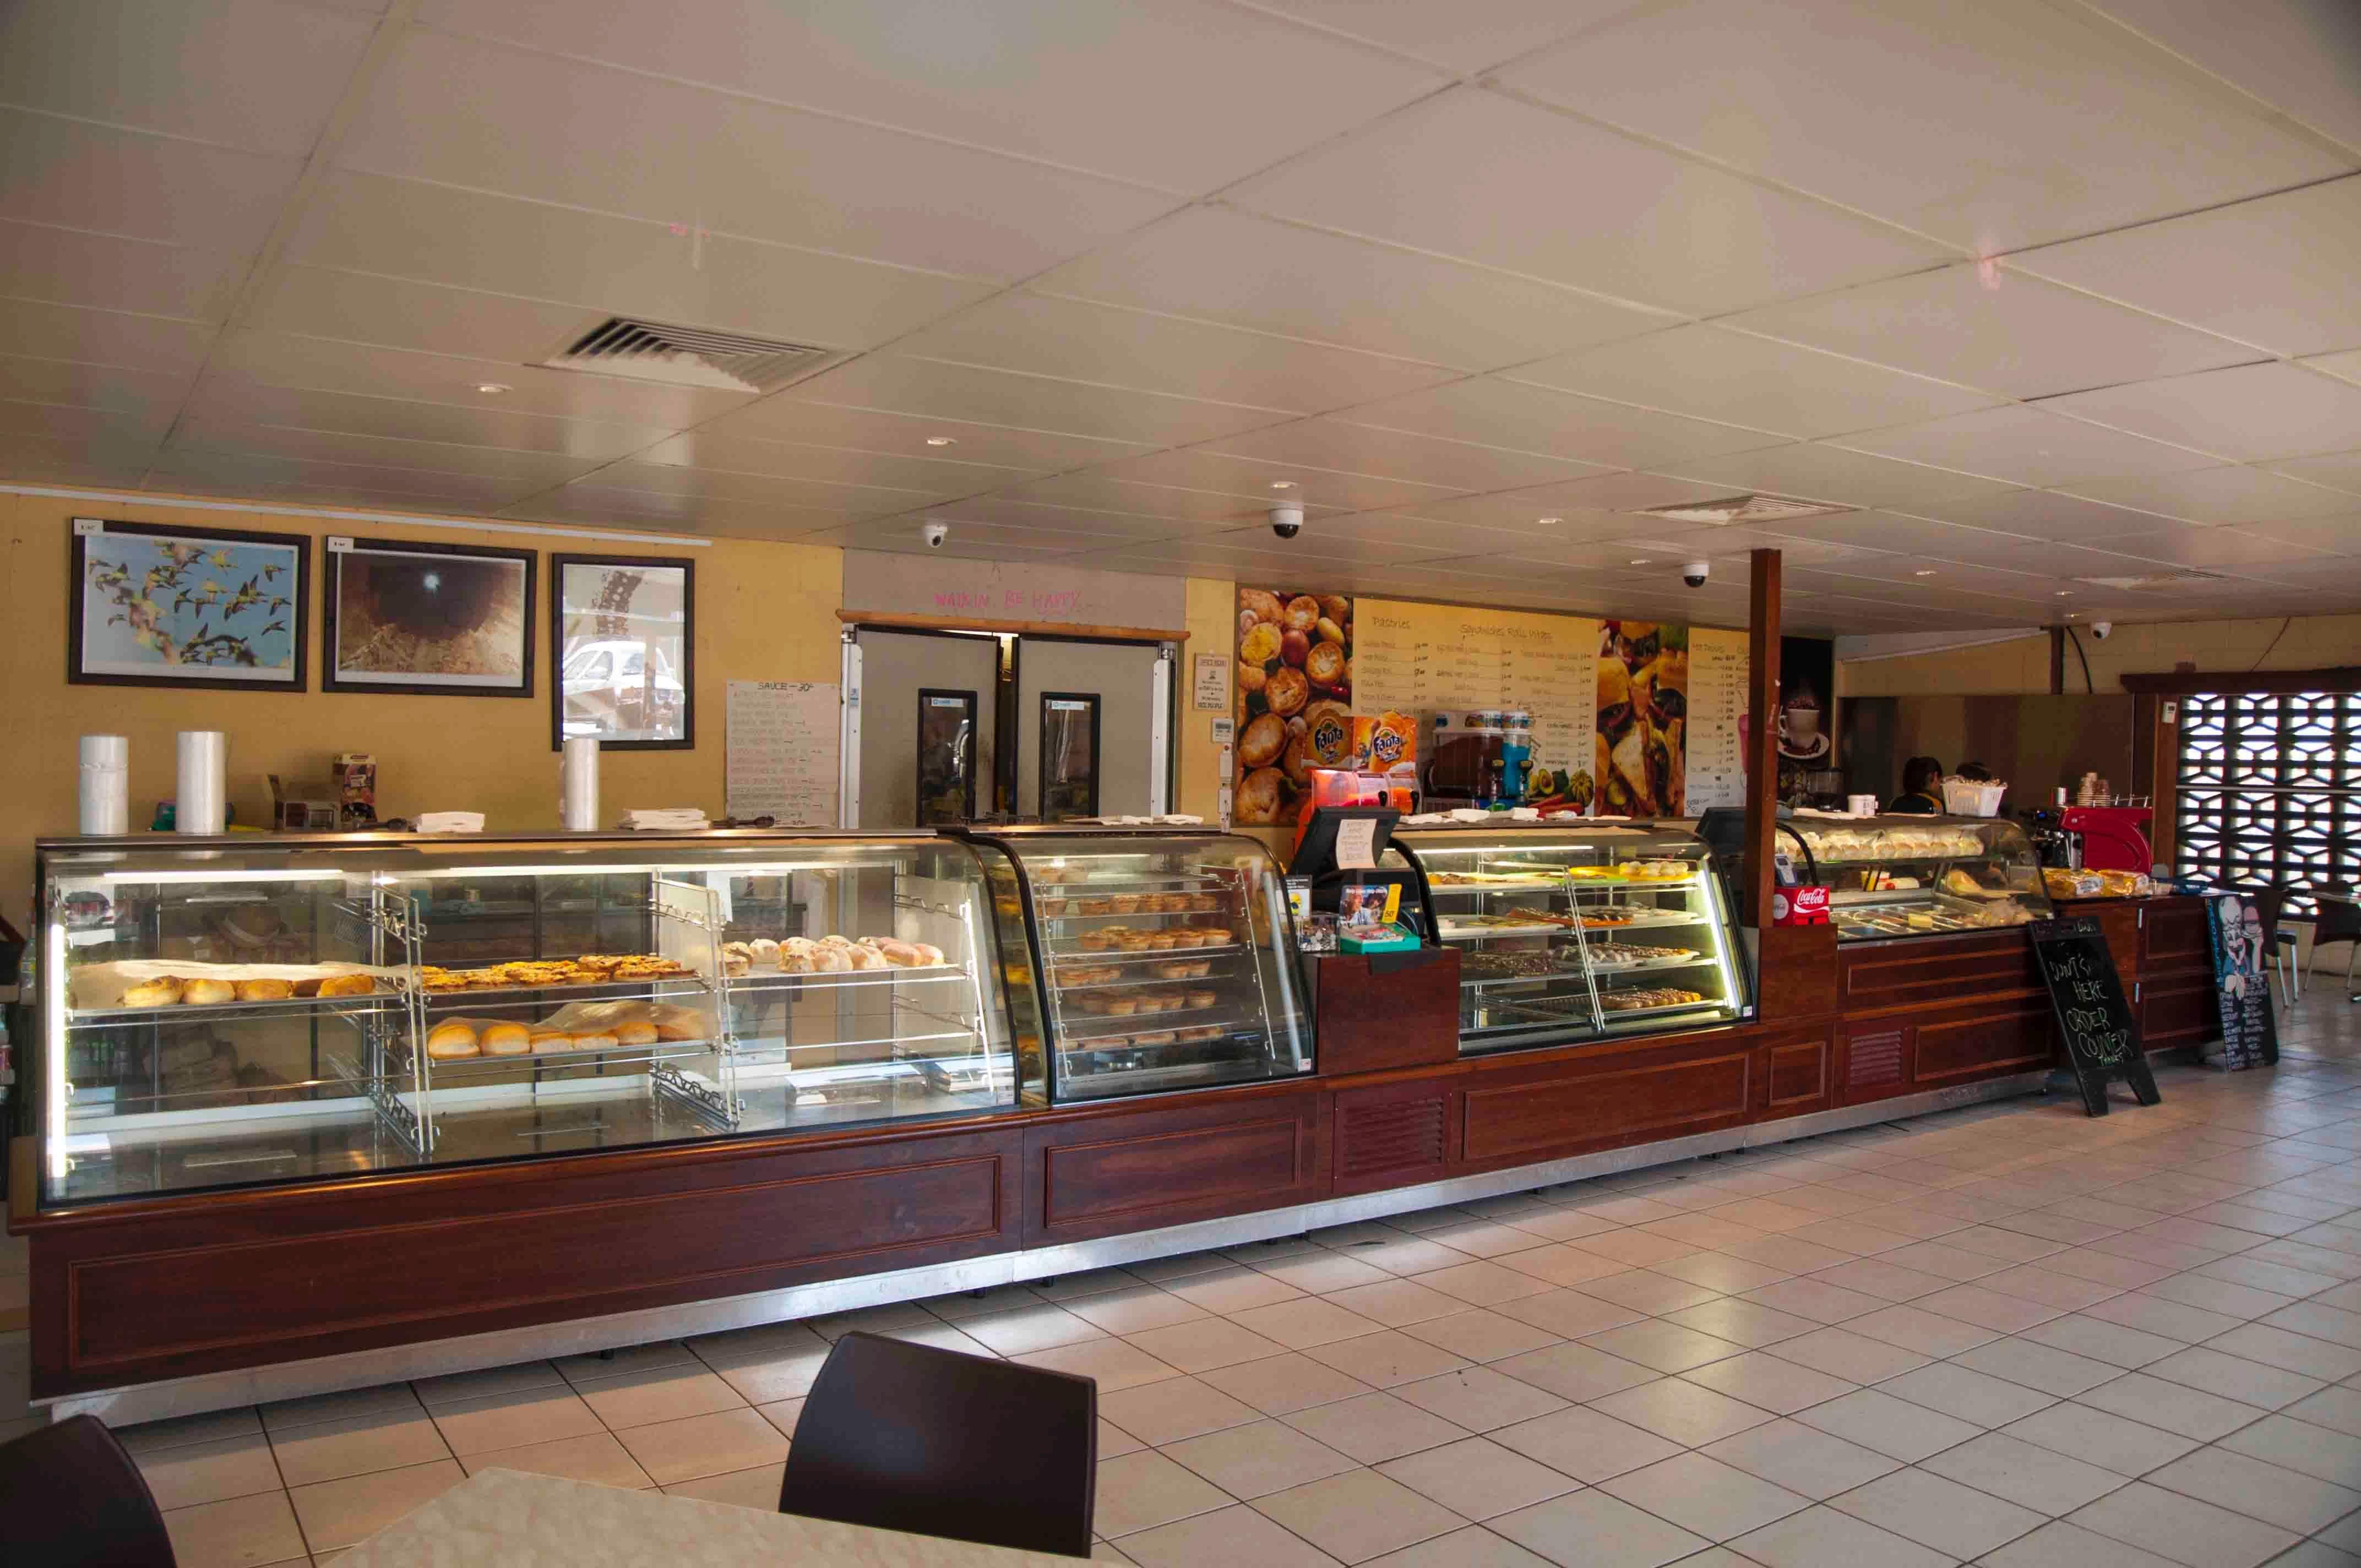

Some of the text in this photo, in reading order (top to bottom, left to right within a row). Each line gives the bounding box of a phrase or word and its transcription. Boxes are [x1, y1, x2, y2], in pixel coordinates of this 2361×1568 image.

[1314, 727, 1343, 752] Fanta
[1373, 734, 1401, 753] Fanta
[2066, 1006, 2110, 1032] ORDER
[2078, 1028, 2133, 1058] COUNTER
